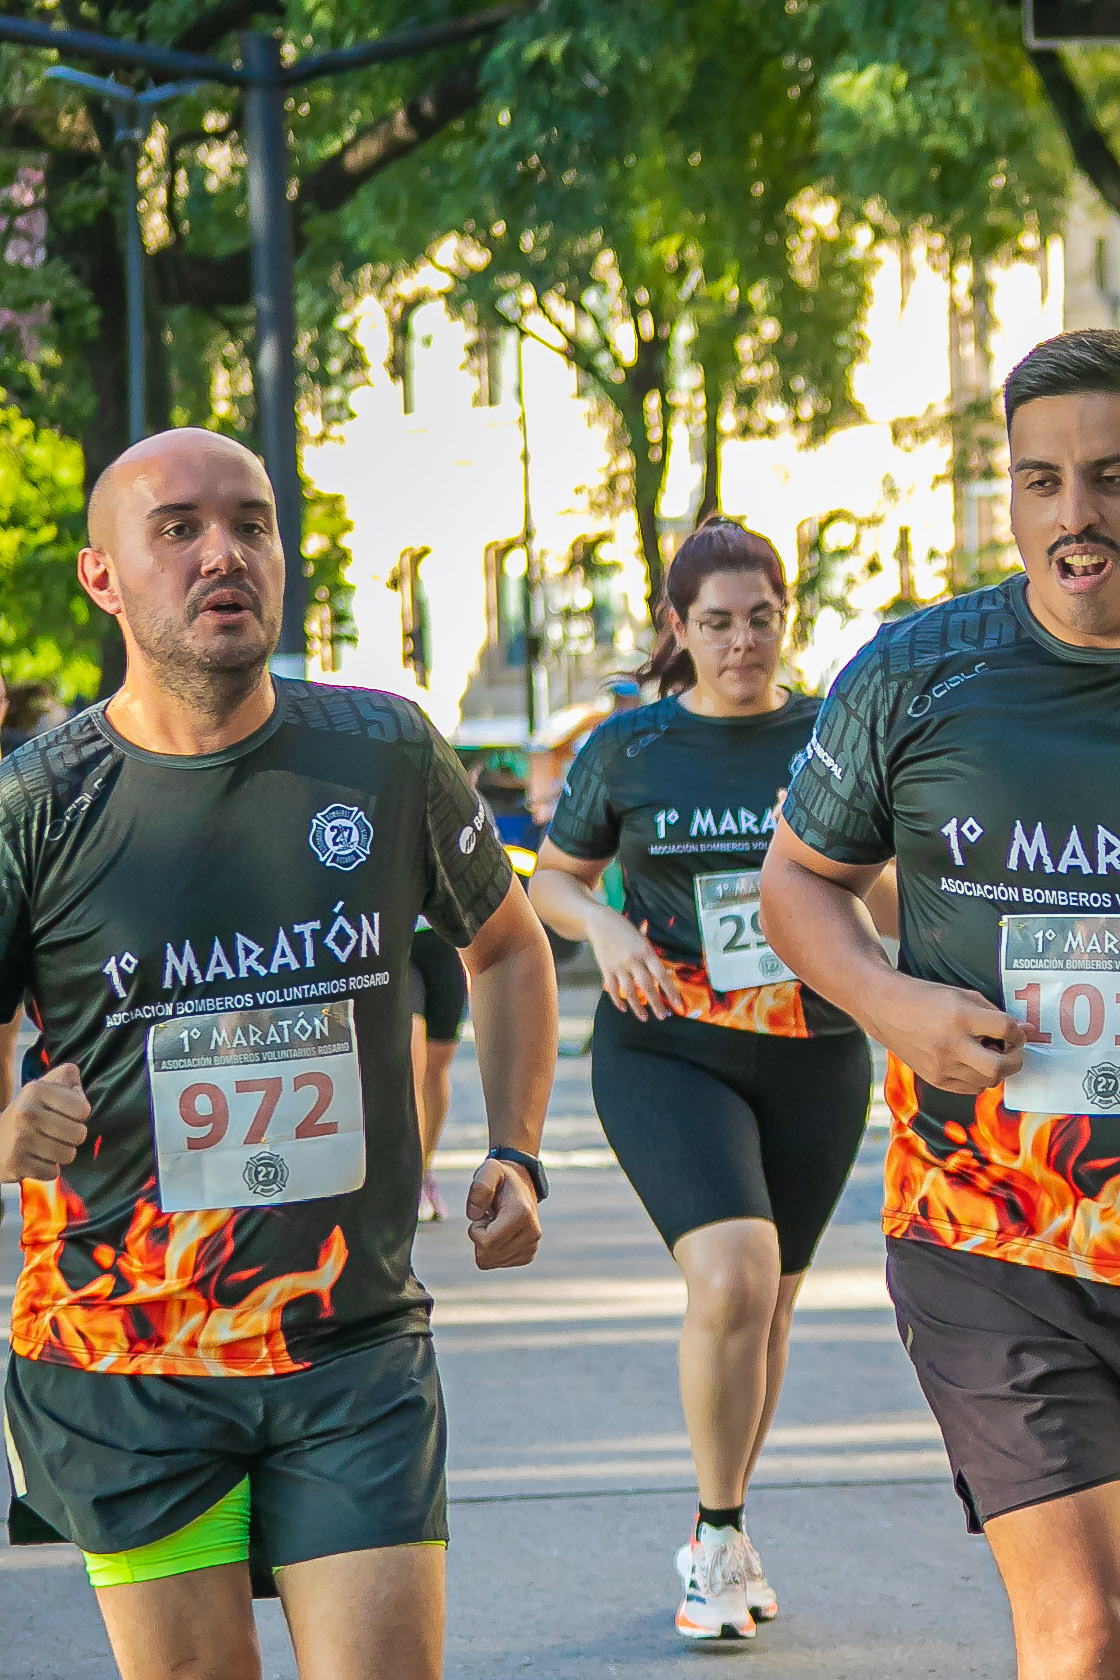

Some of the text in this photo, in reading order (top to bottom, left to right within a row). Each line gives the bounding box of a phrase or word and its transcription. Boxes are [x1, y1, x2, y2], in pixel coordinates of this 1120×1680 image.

[329, 824, 354, 847] 27
[688, 807, 777, 837] MARA
[940, 876, 1019, 902] ASOCIACIÓN
[1022, 888, 1112, 909] BOMBEROS
[162, 900, 381, 990] MARATÓN
[1012, 958, 1064, 969] ASOCIACIÓN
[1065, 959, 1113, 970] BOMBEROS
[175, 993, 254, 1016] BOMBEROS
[256, 978, 347, 1005] VOLUNTARIOS
[348, 971, 390, 990] ROSARIO
[209, 1011, 330, 1050] MARATÓN
[160, 1042, 350, 1071] ASOCIACIÓN BOMBEROS VOLUNTARIOS ROSARIO
[1097, 1076, 1115, 1092] 27
[178, 1071, 339, 1151] 972
[256, 1166, 276, 1181] 27
